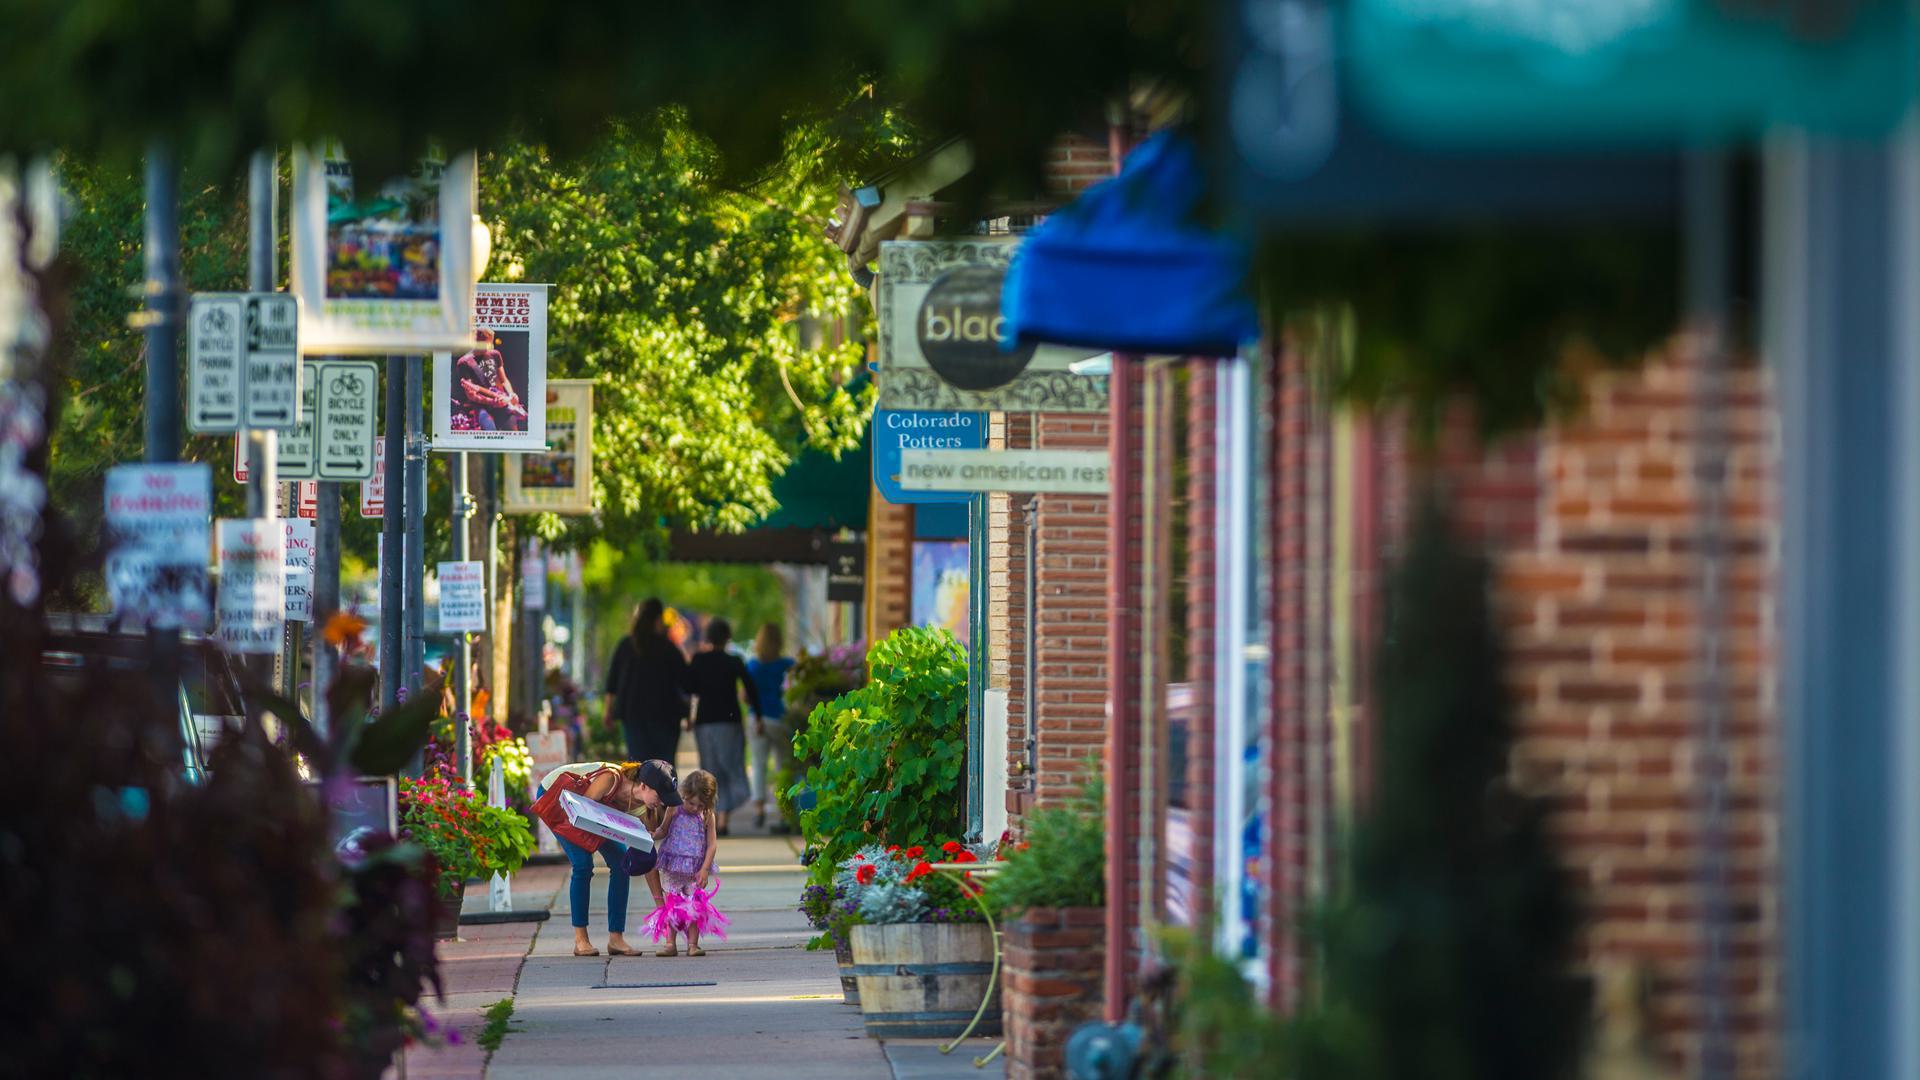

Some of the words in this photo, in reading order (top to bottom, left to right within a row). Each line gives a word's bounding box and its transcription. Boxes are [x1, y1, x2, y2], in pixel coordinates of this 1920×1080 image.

[475, 297, 530, 308] MMER
[475, 307, 530, 316] USIC
[479, 316, 529, 324] TIVALS
[926, 305, 1009, 342] blac
[328, 398, 364, 410] BICYCLE
[328, 414, 364, 426] PARKING
[886, 413, 972, 429] Colorado
[332, 429, 358, 440] ONLY
[897, 434, 962, 448] Potters
[328, 446, 341, 456] ALL
[344, 445, 364, 457] TIMES
[906, 464, 956, 480] new
[960, 460, 1067, 481] american
[1072, 464, 1106, 482] res
